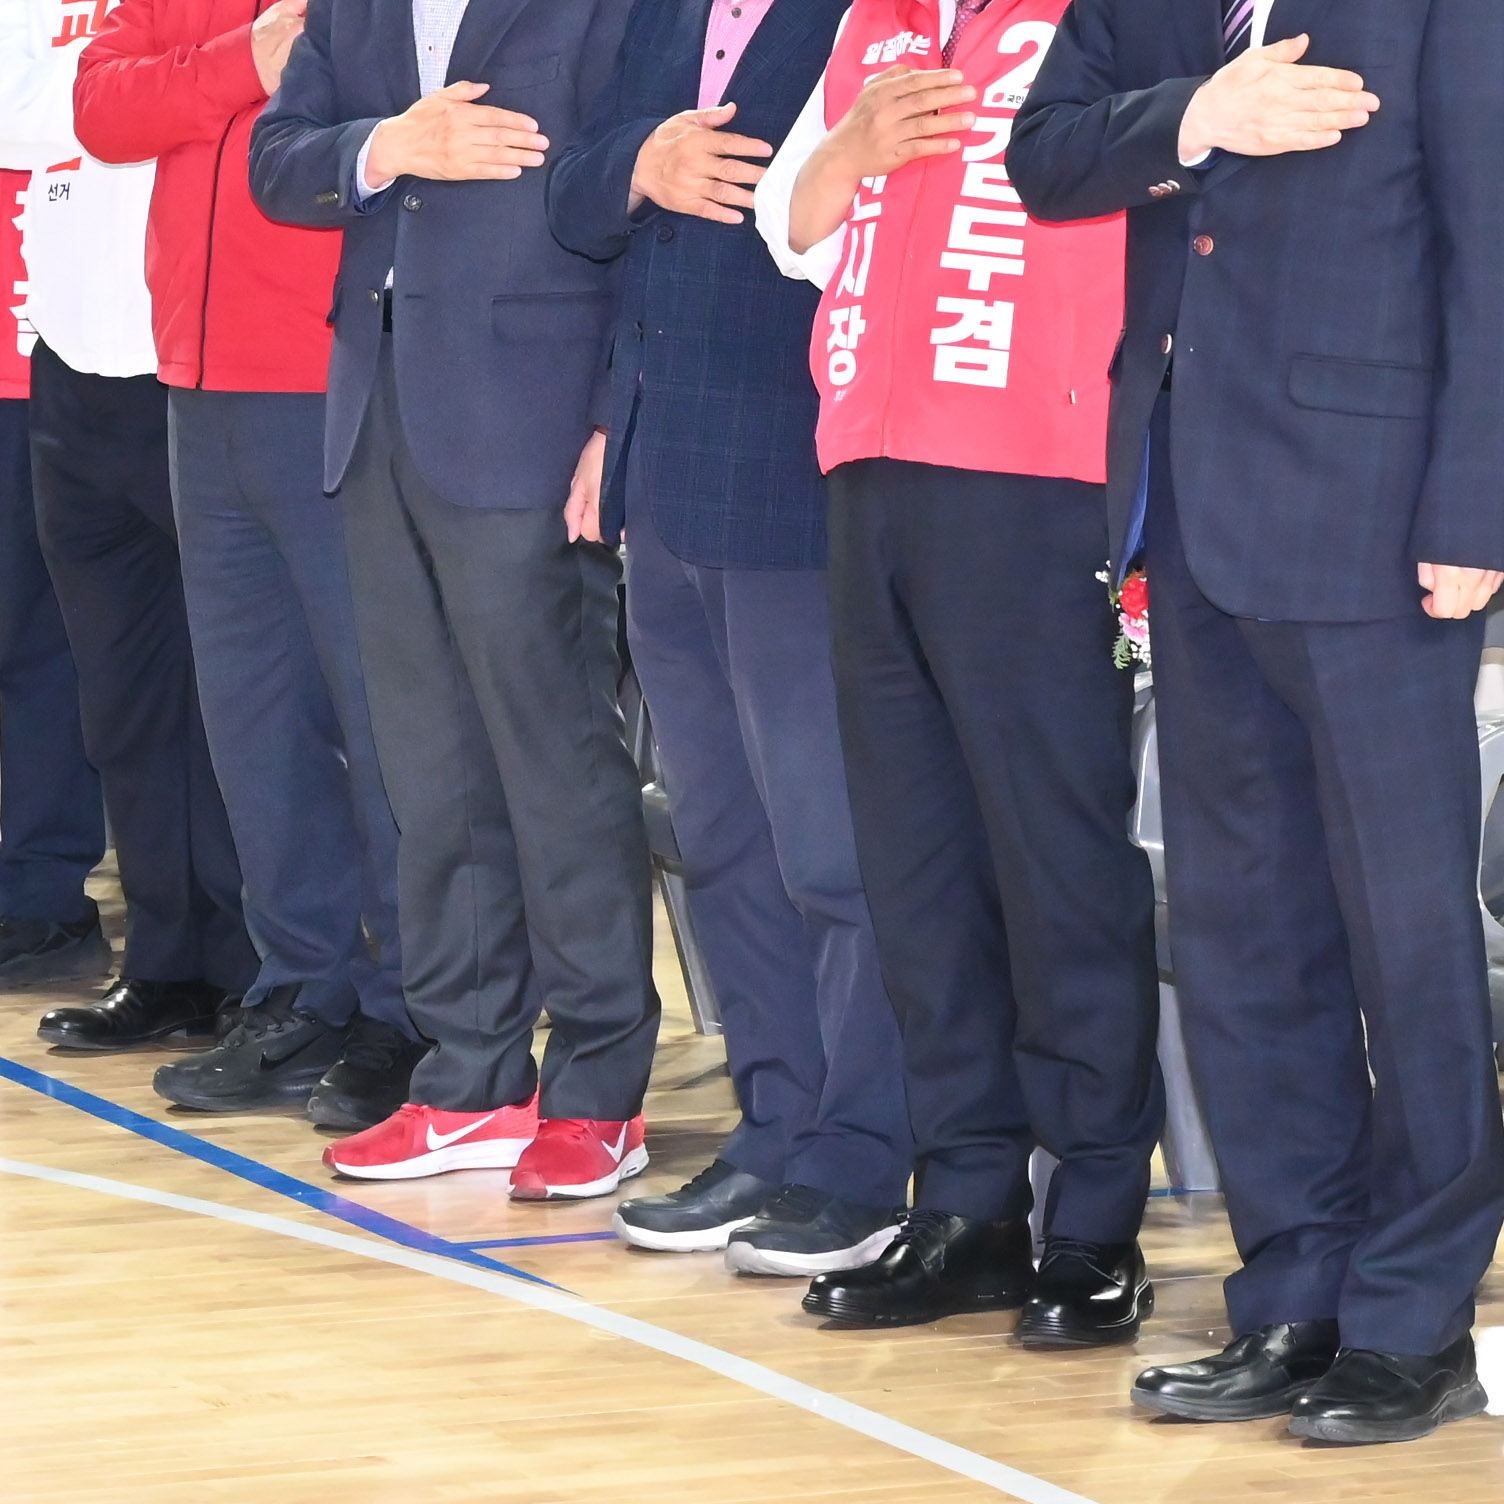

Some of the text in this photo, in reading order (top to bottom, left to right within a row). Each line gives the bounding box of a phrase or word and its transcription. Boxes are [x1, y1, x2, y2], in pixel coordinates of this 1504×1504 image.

[861, 31, 931, 66] 일잘하는
[47, 182, 72, 203] 선거
[929, 117, 1029, 389] 김두겸
[827, 174, 888, 387] 시장
